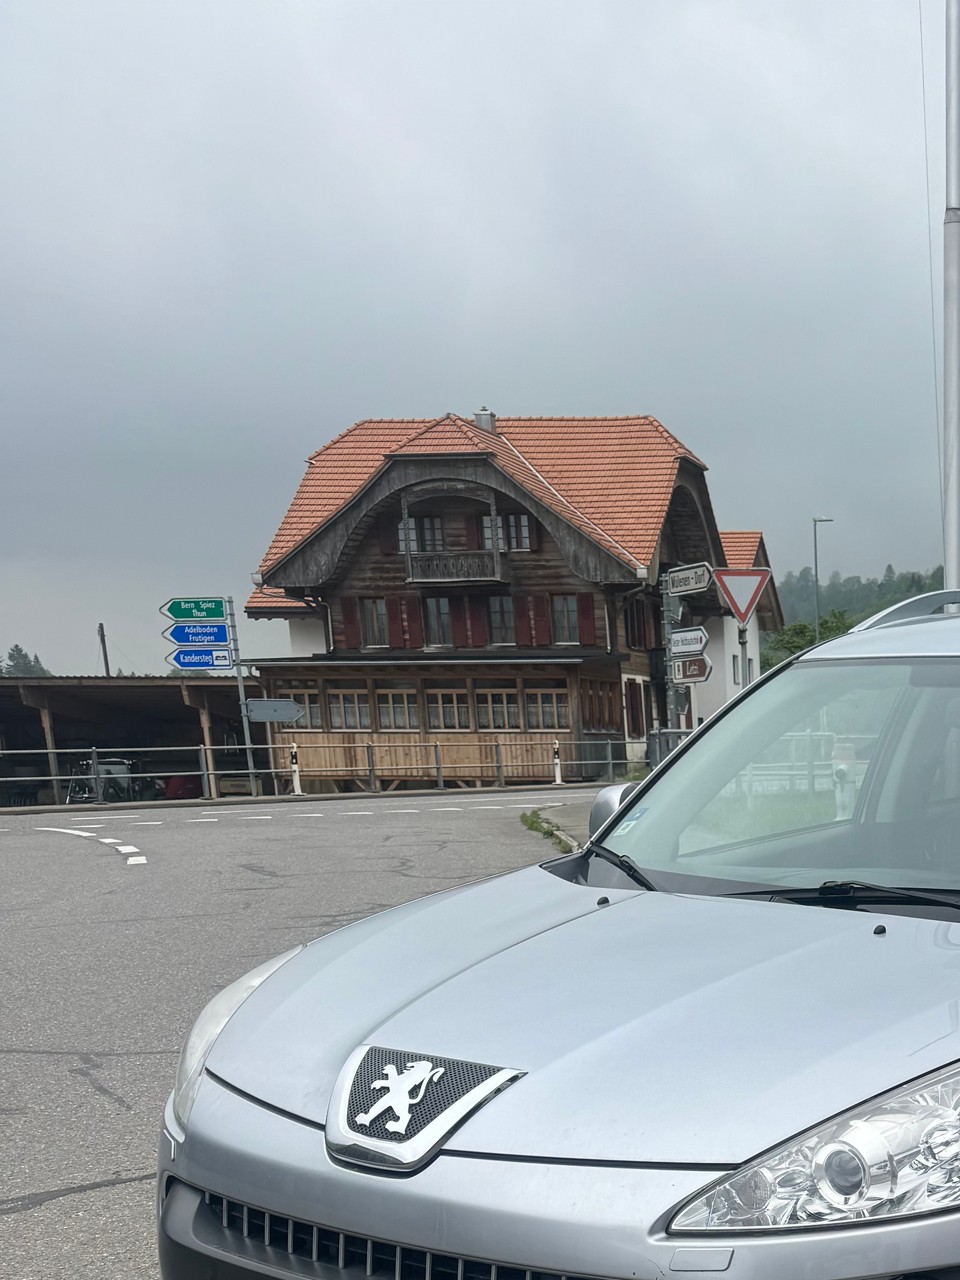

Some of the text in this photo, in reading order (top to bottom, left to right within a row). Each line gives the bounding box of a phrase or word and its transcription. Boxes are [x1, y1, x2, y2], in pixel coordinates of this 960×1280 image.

[200, 601, 215, 609] Spiez
[192, 609, 206, 617] Thun
[189, 634, 215, 643] Frutigen
[180, 653, 213, 664] Kandersteg
